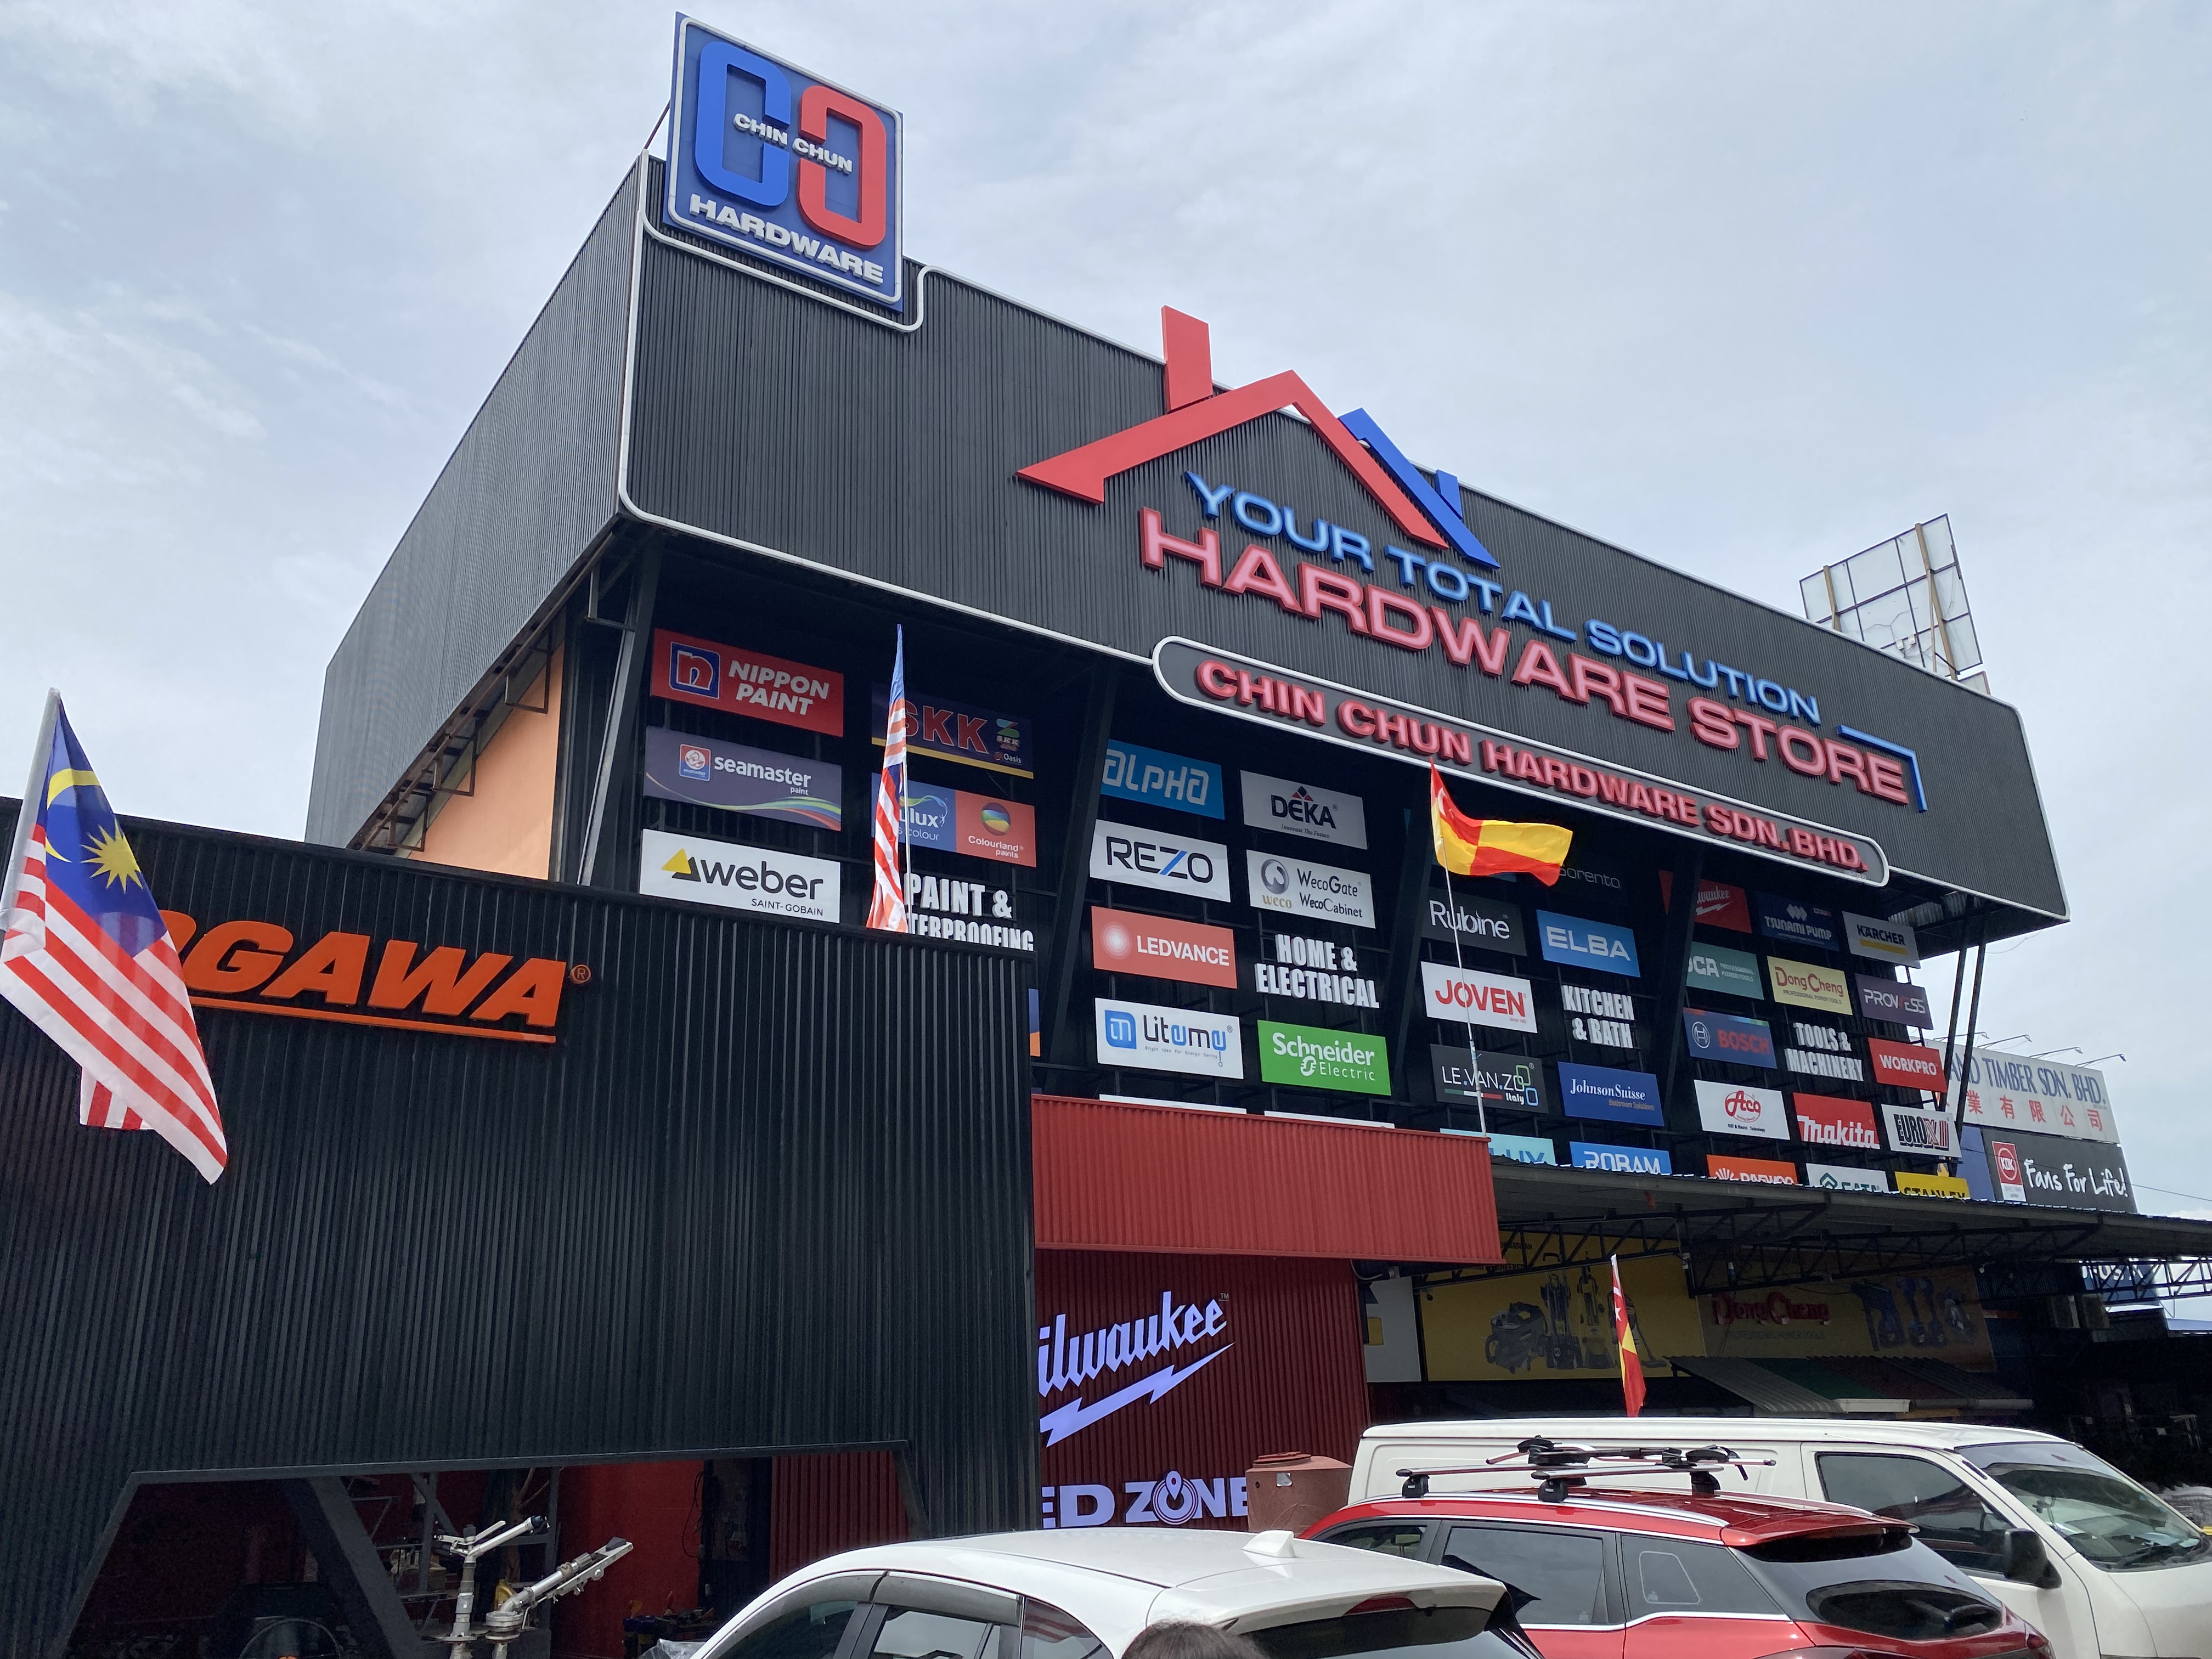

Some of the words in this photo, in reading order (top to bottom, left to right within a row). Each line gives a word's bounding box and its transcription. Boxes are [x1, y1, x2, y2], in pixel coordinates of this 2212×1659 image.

[733, 113, 788, 146] CHIN
[792, 137, 853, 174] CHUN
[689, 193, 884, 285] HARDWARE
[1183, 471, 1375, 573] YOUR
[1384, 545, 1577, 642] TOTAL
[1584, 618, 1821, 727] SOLUTION
[1139, 506, 1675, 732] HARDWARE
[1687, 696, 1909, 806] STORE
[729, 659, 830, 699] NIPPON
[736, 682, 814, 715] PAINT
[1003, 753, 1022, 764] Oasis
[1196, 659, 1326, 725] CHIN
[1337, 699, 1472, 765] CHUN
[1480, 738, 1701, 828] HARDWARE
[714, 757, 811, 787] seamaster
[790, 786, 809, 795] paint
[1271, 794, 1336, 830] DEKA
[968, 835, 1019, 852] Colourland
[996, 849, 1019, 859] paints
[1107, 836, 1213, 884] REZO
[700, 860, 823, 900] weber
[904, 872, 986, 917] PAINT
[992, 889, 1012, 919] &
[1296, 868, 1358, 897] WecoGate
[751, 898, 823, 916] SAINT-GOBAIN
[1262, 894, 1292, 909] weco
[1299, 891, 1363, 918] WecoCabinet
[1429, 900, 1510, 939] Rubine
[1764, 916, 1805, 934] TSUNAMI
[1805, 925, 1832, 940] PUMP
[1137, 935, 1230, 967] LEDVANCE
[1275, 933, 1337, 971] HOME
[1341, 946, 1357, 972] &
[1546, 926, 1631, 962] ELBA
[1254, 962, 1380, 1009] ELECTRICAL
[1435, 979, 1526, 1018] JOVEN
[1561, 984, 1635, 1022] KITCHEN
[1273, 1032, 1375, 1066] Schneider
[1572, 1017, 1588, 1041] &
[1589, 1018, 1634, 1049] BATH
[1716, 1029, 1770, 1055] BOSCH
[1793, 1022, 1839, 1051] TOOLS
[1838, 1031, 1852, 1052] &
[1319, 1056, 1375, 1082] Electric
[1784, 1048, 1864, 1082] MACHINERY
[1878, 1053, 1937, 1077] WORKPRO
[1982, 1057, 2038, 1094] TIMBER
[2037, 1067, 2072, 1099] SDN.
[2071, 1073, 2106, 1105] BHD.
[1505, 1092, 1525, 1105] Italy
[1946, 1090, 2103, 1132] 業有限公司
[2000, 1157, 2015, 1171] KDK
[2023, 1159, 2063, 1192] Fans
[2063, 1163, 2087, 1194] For
[2089, 1167, 2129, 1198] Life!
